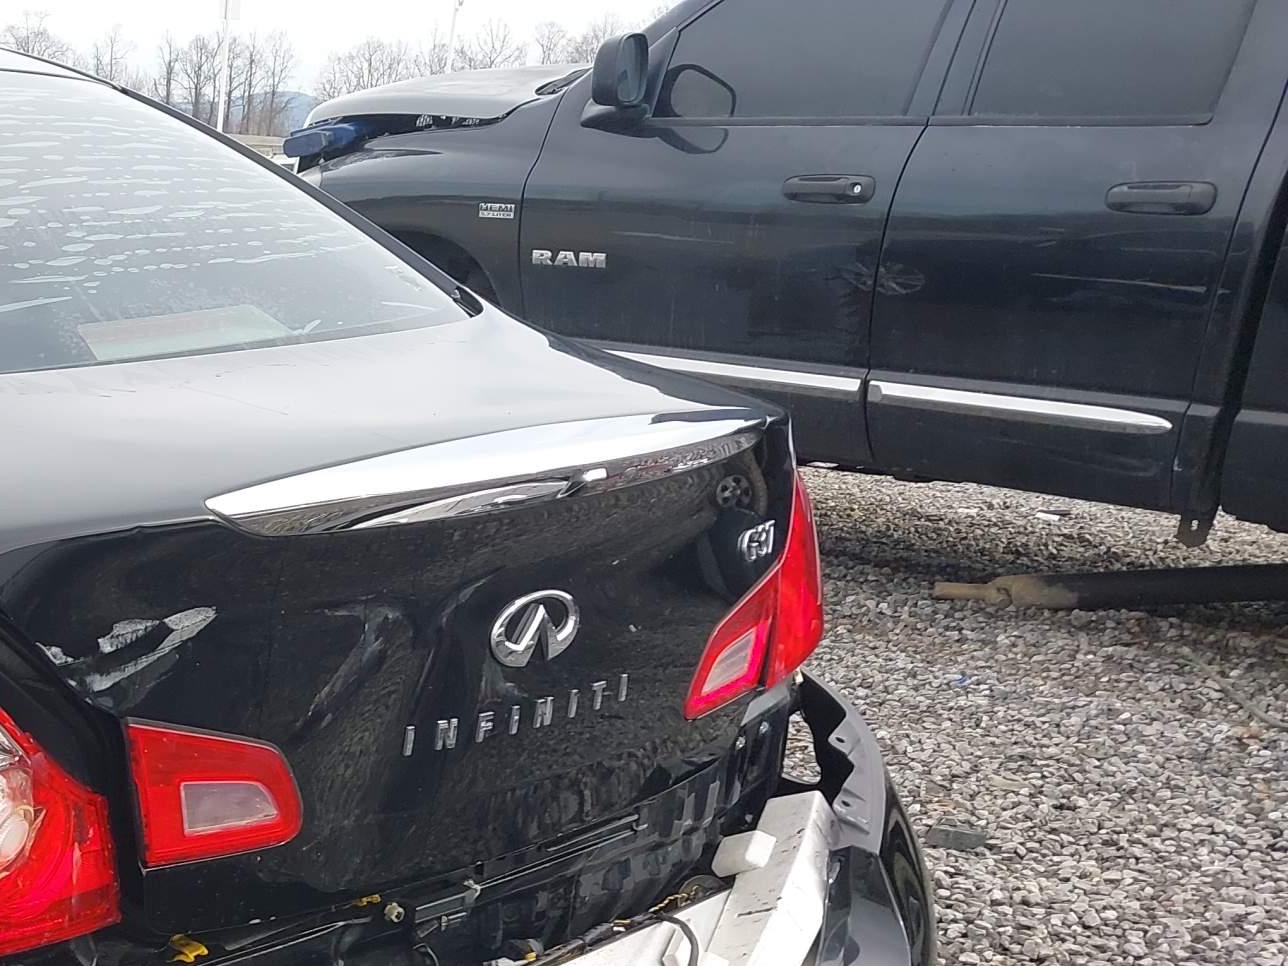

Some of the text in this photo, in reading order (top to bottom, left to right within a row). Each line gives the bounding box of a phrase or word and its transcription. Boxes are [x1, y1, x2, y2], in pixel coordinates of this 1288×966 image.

[479, 202, 515, 212] HEMI
[531, 249, 607, 268] RAM
[402, 673, 629, 757] INFINITI
